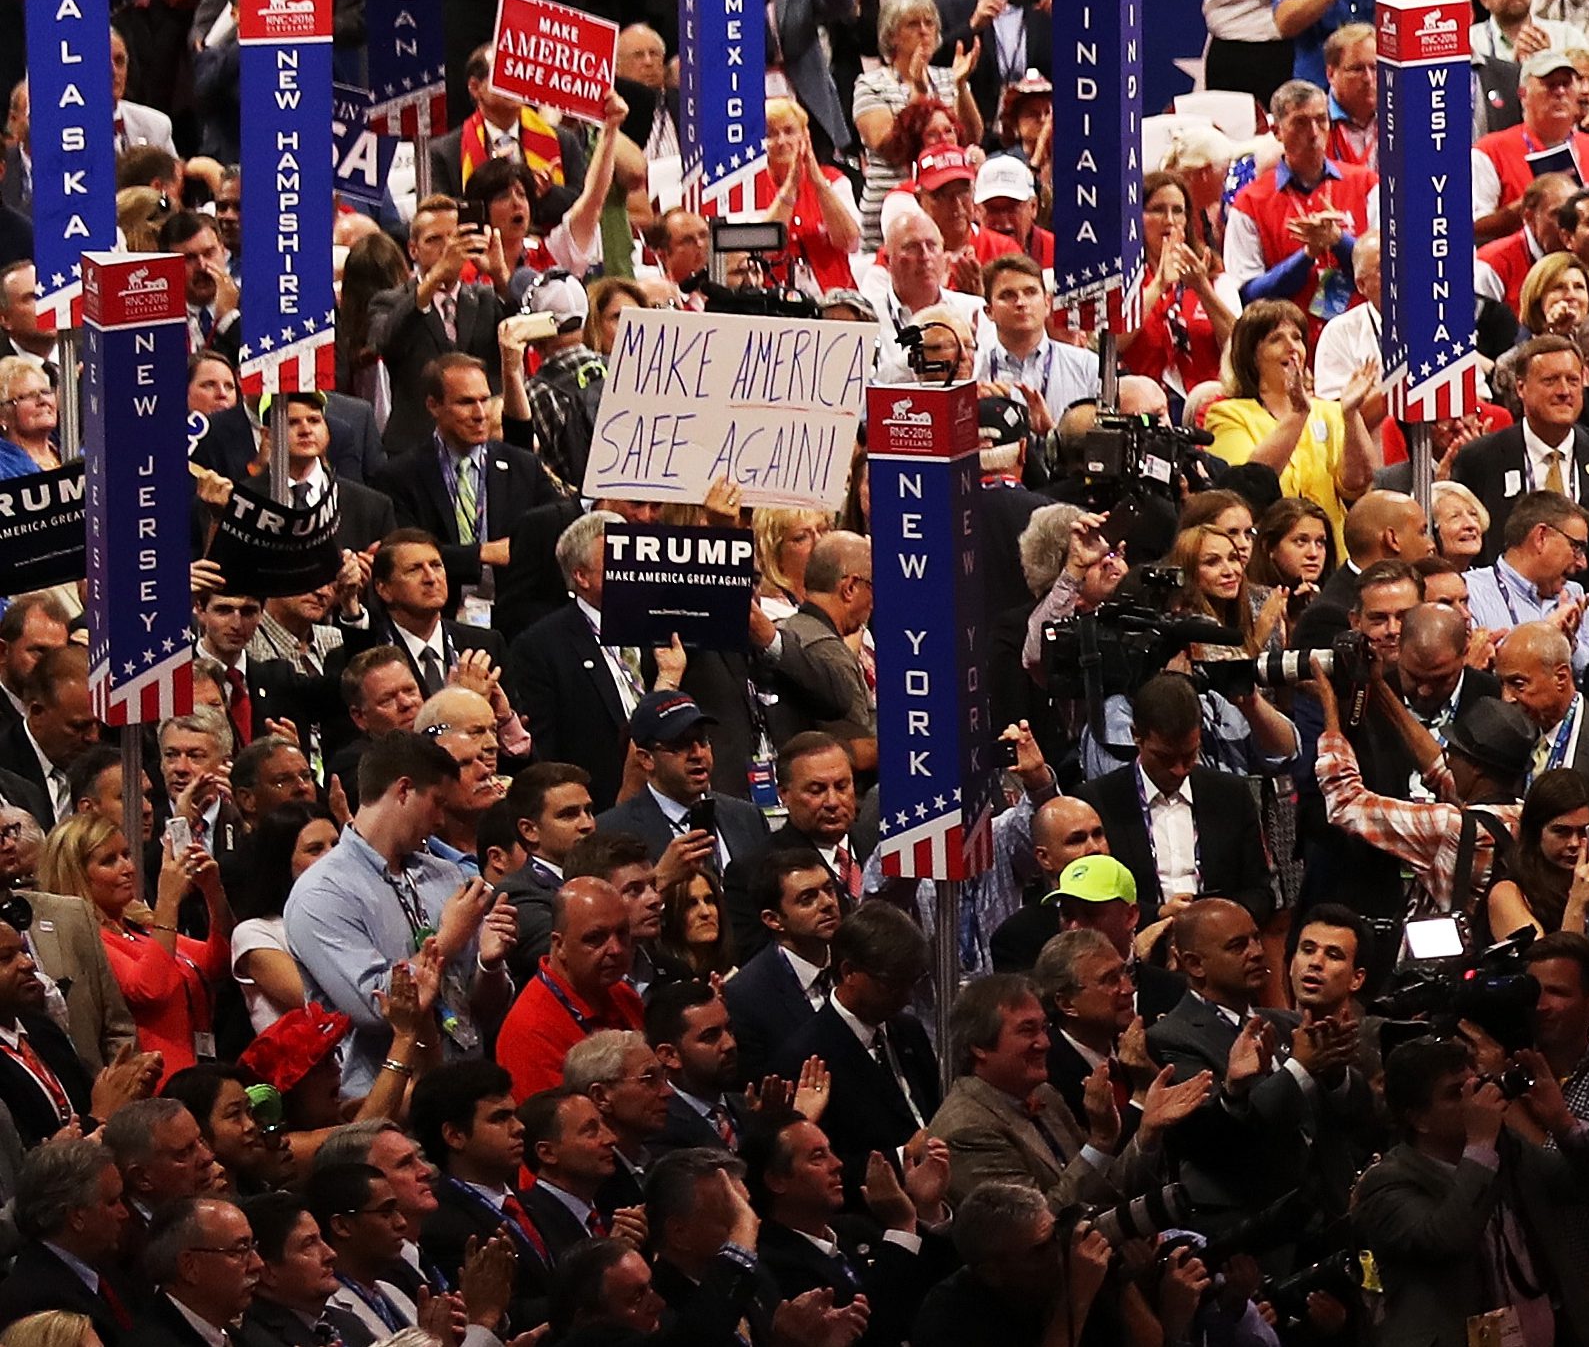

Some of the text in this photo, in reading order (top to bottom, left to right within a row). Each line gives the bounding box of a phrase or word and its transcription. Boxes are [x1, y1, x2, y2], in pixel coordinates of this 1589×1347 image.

[498, 27, 612, 85] AMERICA
[538, 16, 580, 44] MAKE
[504, 57, 602, 102] SAFE AGAIN
[1076, 6, 1098, 244] INDIANA
[1127, 4, 1138, 242] INDIANA
[274, 50, 301, 314] NEW HAMPSHIRE
[1384, 68, 1398, 342] WEST VIRGINIA
[1428, 68, 1450, 342] WEST VIRGINIA
[88, 332, 98, 416] NEW
[612, 320, 866, 408] MAKE AMERICA
[134, 332, 158, 633] NEW JERSEY
[597, 410, 837, 499] SAFE AGAIN!
[890, 438, 933, 448] CLEVELAND
[0, 474, 87, 518] RUM
[50, 508, 87, 537] GREAT
[221, 520, 252, 545] MAKE
[605, 570, 752, 588] MAKE AMERICA GREAT AGAIN!
[606, 534, 753, 566] TRUMP
[898, 472, 932, 777] NEW YORK
[961, 469, 980, 774] NEW YORK
[1350, 690, 1365, 726] Canon
